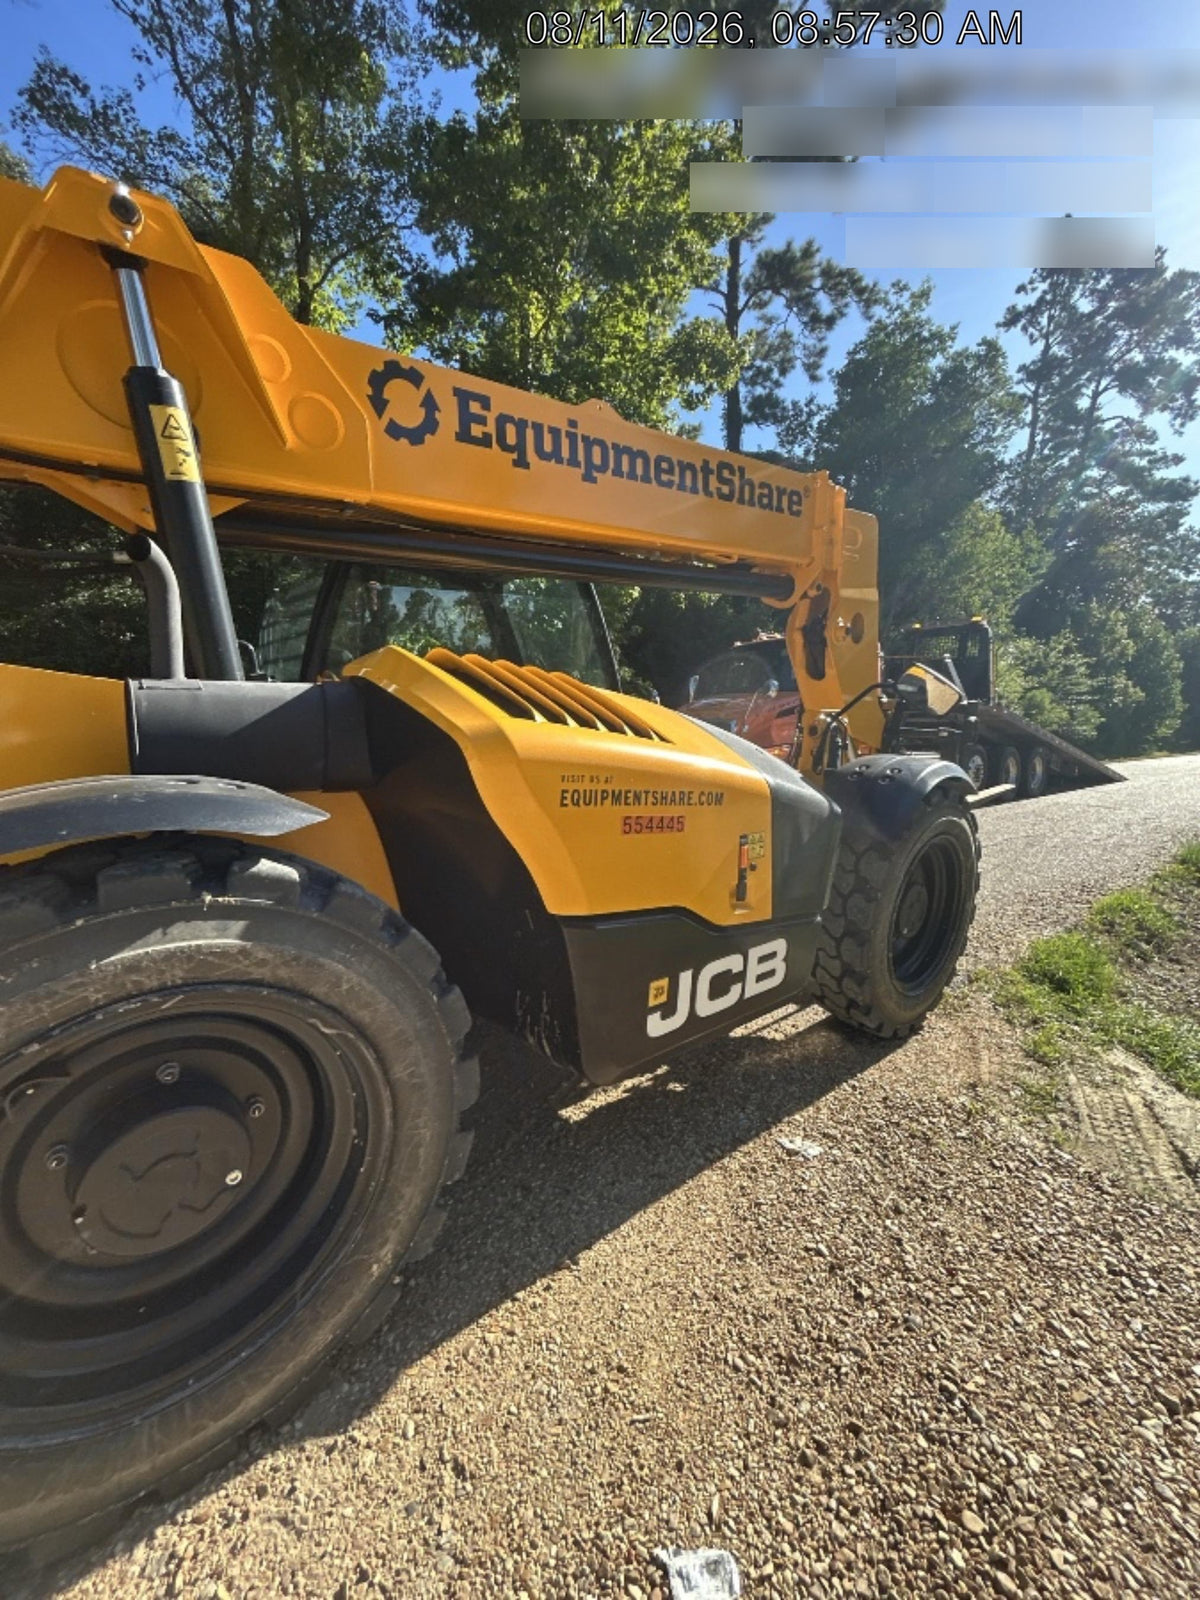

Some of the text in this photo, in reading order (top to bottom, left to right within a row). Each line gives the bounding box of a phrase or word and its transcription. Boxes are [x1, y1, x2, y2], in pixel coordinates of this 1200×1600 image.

[561, 774, 585, 784] VISIT
[559, 789, 725, 807] EQUIPMENTSHARE.COM
[623, 815, 685, 834] 554445
[647, 938, 787, 1037] JCB
